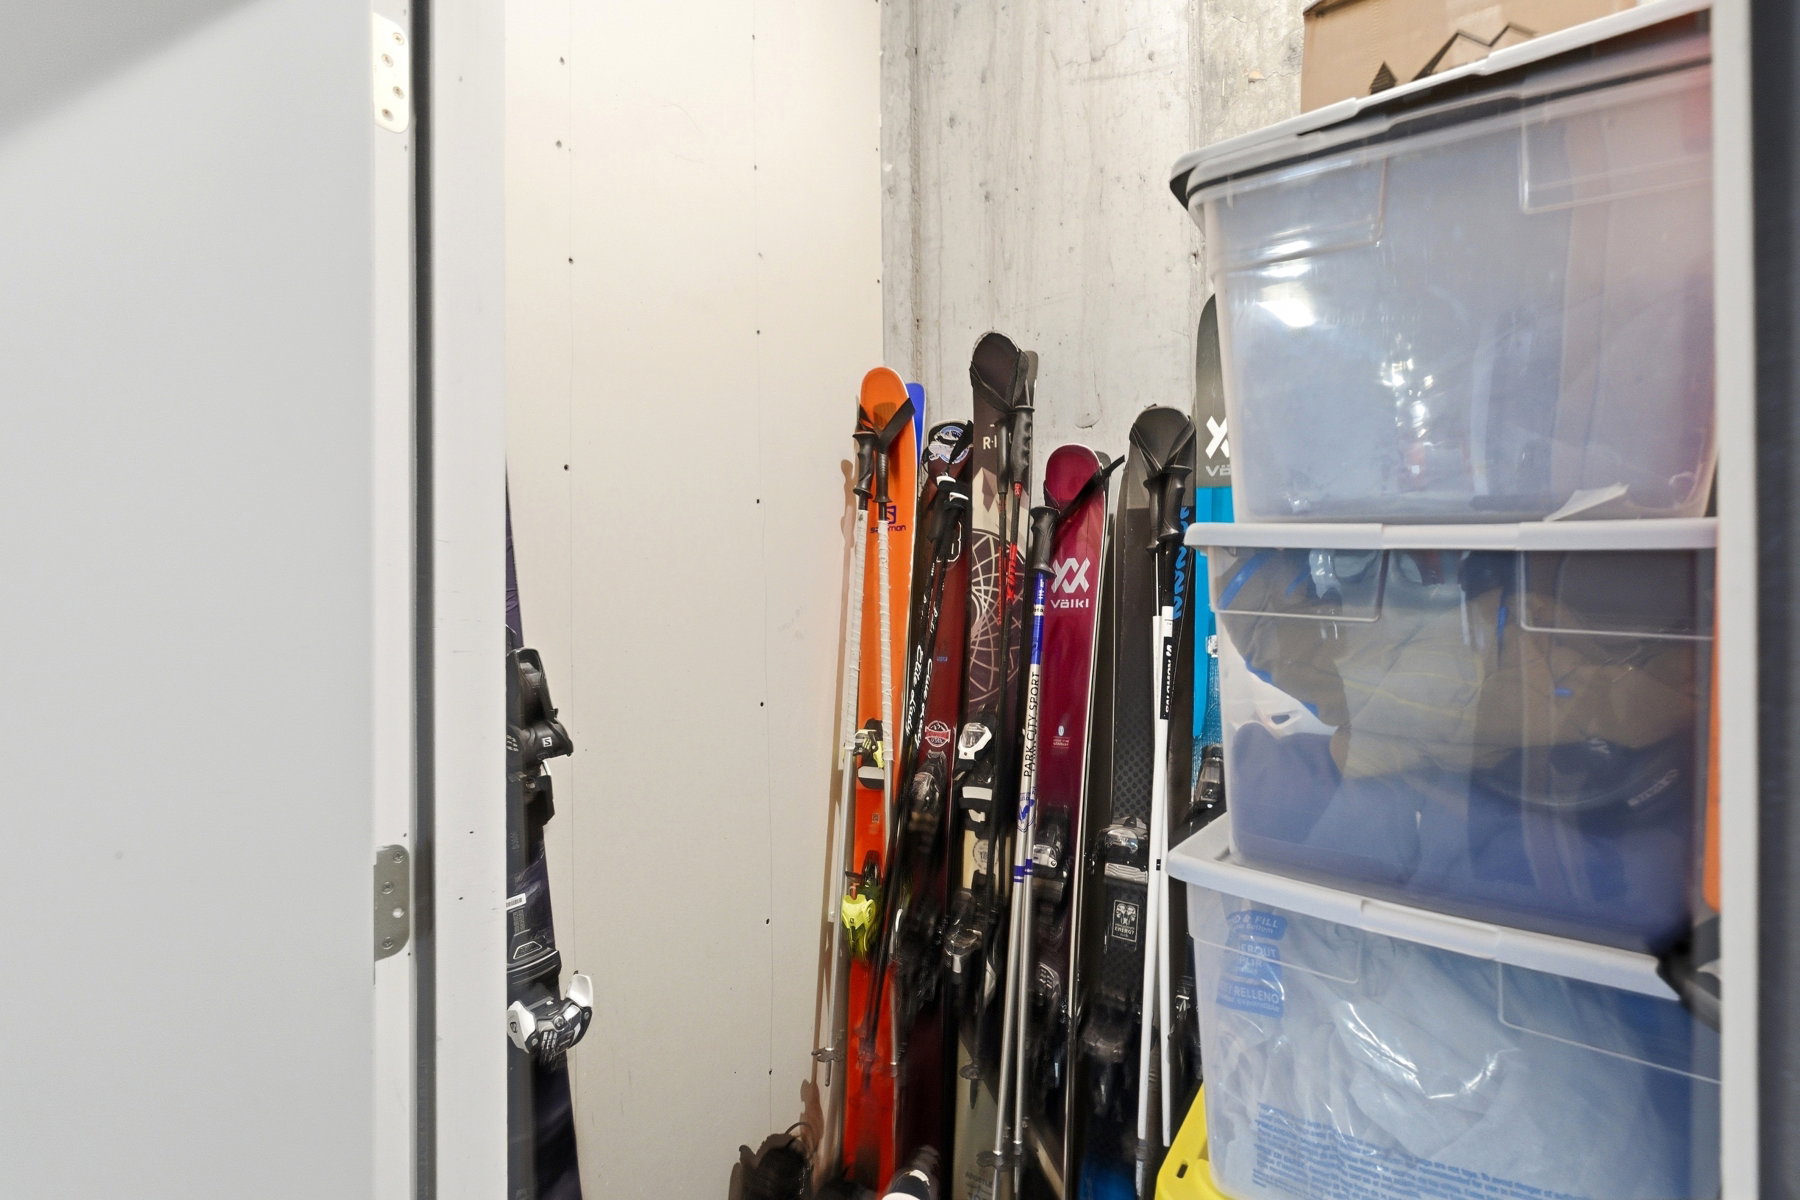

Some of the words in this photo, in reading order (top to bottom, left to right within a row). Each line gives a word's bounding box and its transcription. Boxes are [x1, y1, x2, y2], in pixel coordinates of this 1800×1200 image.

[1050, 598, 1089, 609] Völkl
[1029, 671, 1040, 711] SPORT
[1026, 714, 1036, 741] CITY
[1023, 745, 1034, 778] PARK
[1254, 916, 1279, 929] FILL
